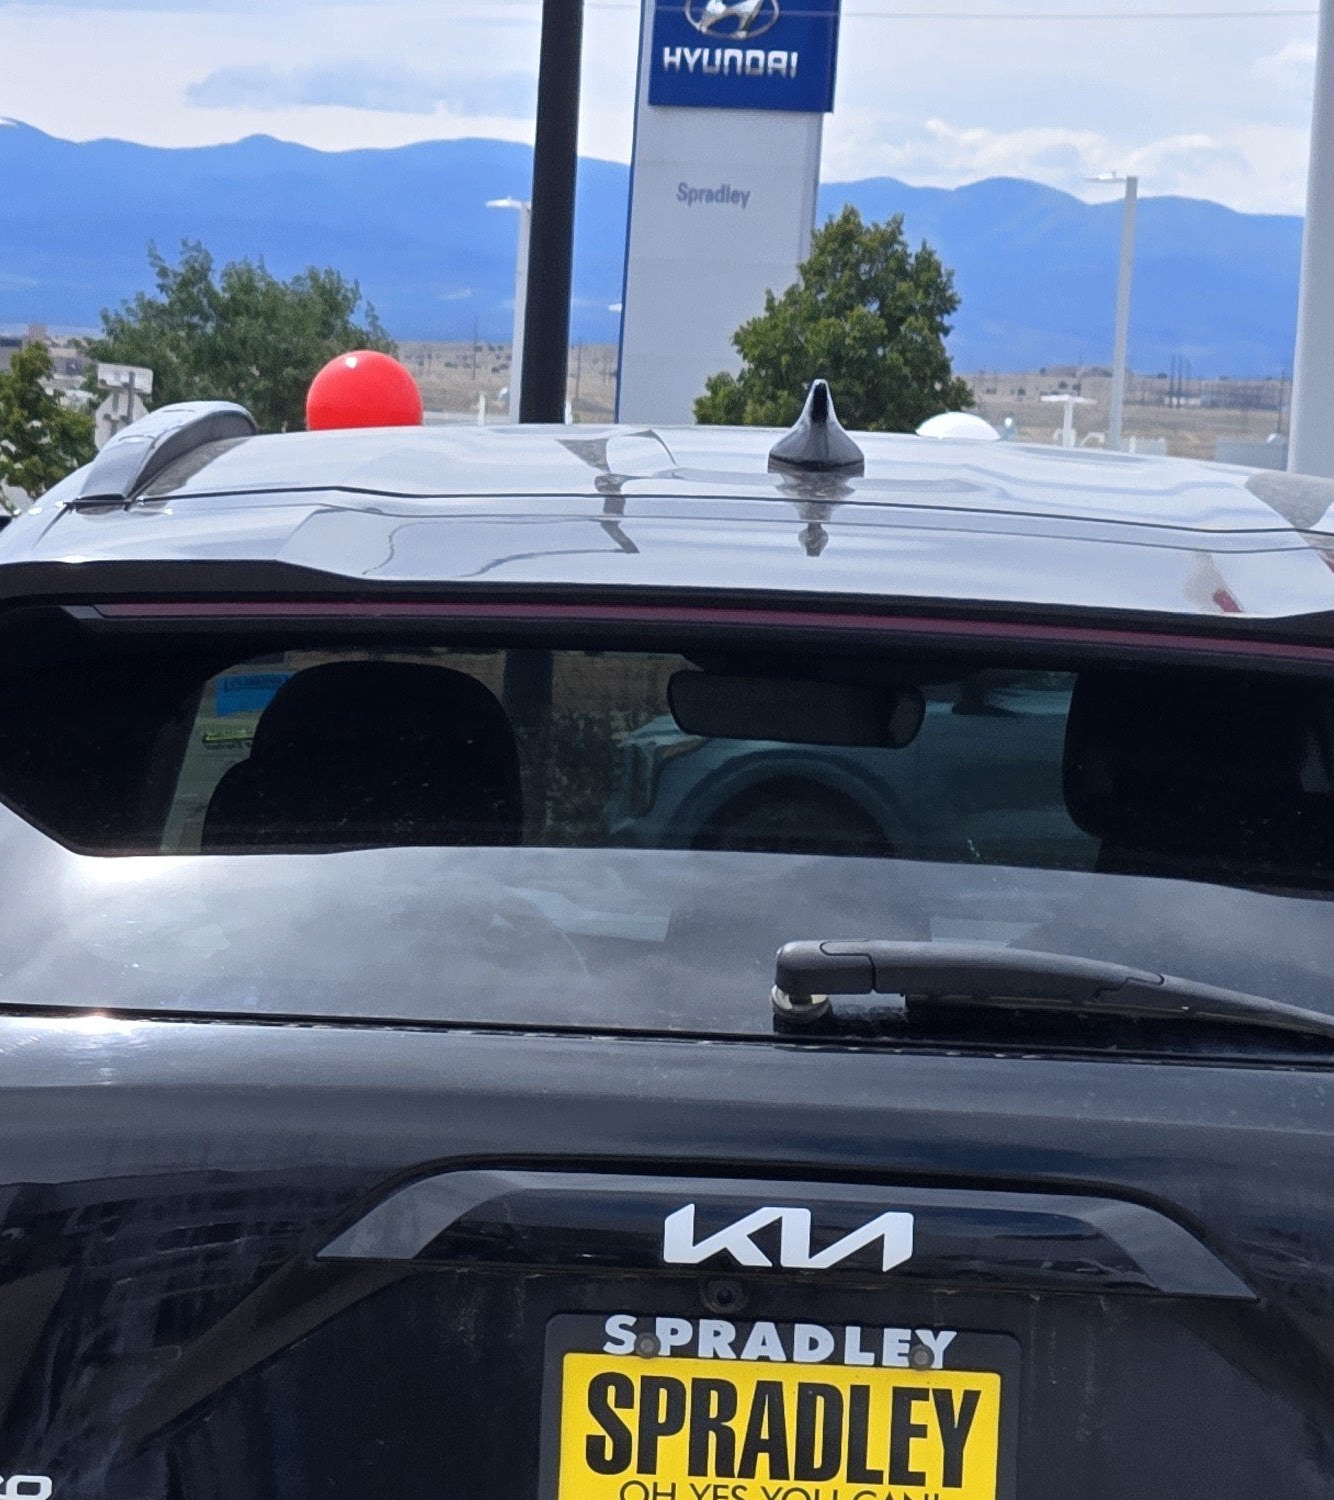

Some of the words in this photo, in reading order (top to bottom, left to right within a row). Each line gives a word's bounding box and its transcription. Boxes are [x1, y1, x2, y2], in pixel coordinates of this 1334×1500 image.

[663, 46, 798, 79] HYUNDAI
[676, 181, 751, 209] Spradley
[663, 1203, 914, 1272] KIA
[603, 1314, 957, 1370] SPRADLEY
[585, 1371, 982, 1489] SPRADLEY
